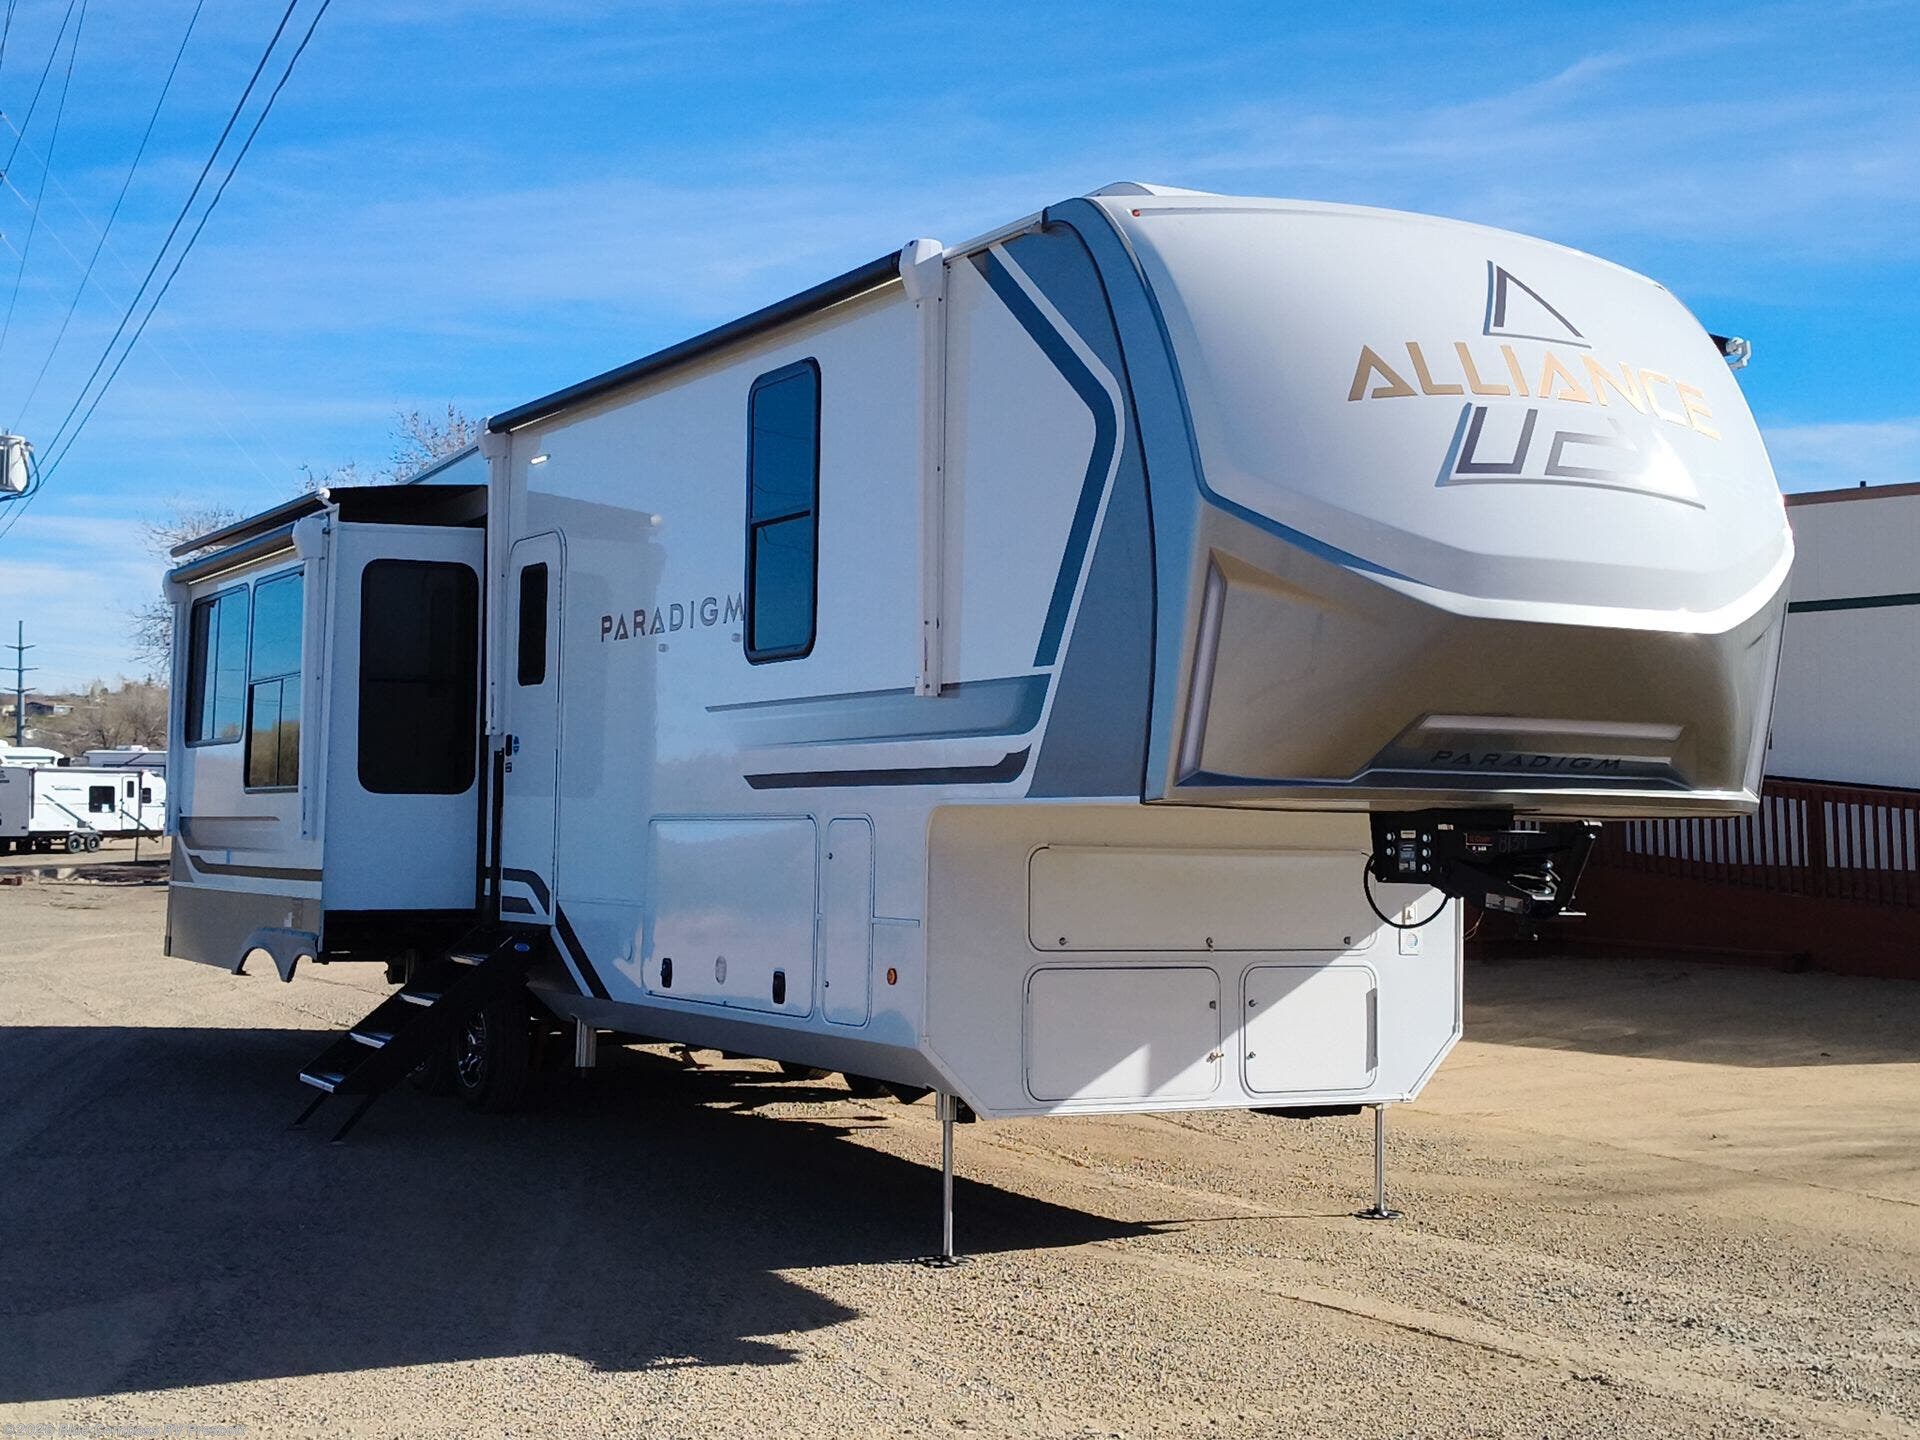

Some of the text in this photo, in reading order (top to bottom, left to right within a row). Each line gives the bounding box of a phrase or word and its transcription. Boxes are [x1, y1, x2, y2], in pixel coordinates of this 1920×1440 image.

[1347, 340, 1722, 441] ALLIANCE
[600, 591, 745, 643] PARADIGM
[1429, 750, 1623, 770] PARADIGM
